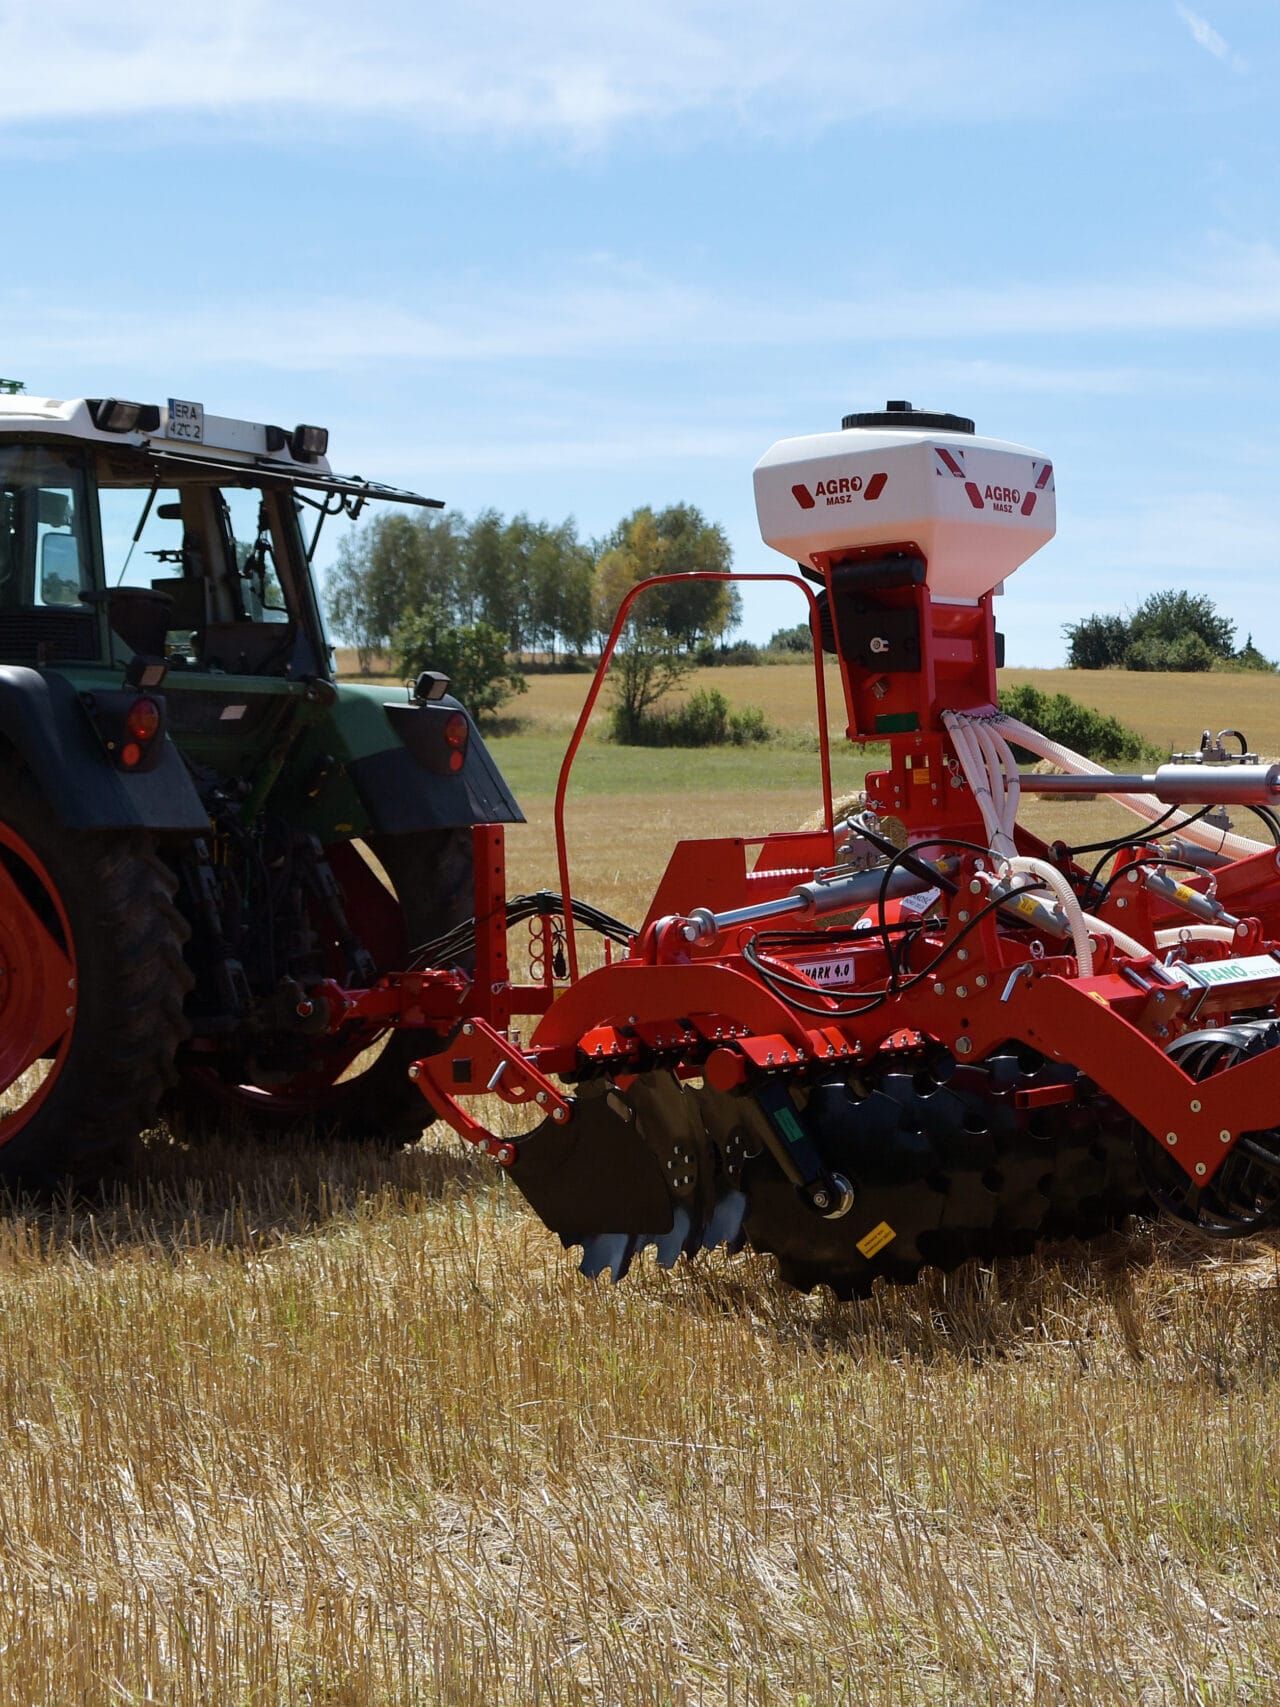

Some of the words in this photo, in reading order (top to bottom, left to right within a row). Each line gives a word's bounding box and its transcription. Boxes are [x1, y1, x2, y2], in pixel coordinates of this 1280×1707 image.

[175, 404, 197, 420] ERA
[816, 476, 863, 496] AGRO
[826, 495, 852, 506] MASZ
[984, 485, 1021, 504] AGRO
[993, 503, 1013, 513] MASZ
[834, 964, 850, 977] 4.0
